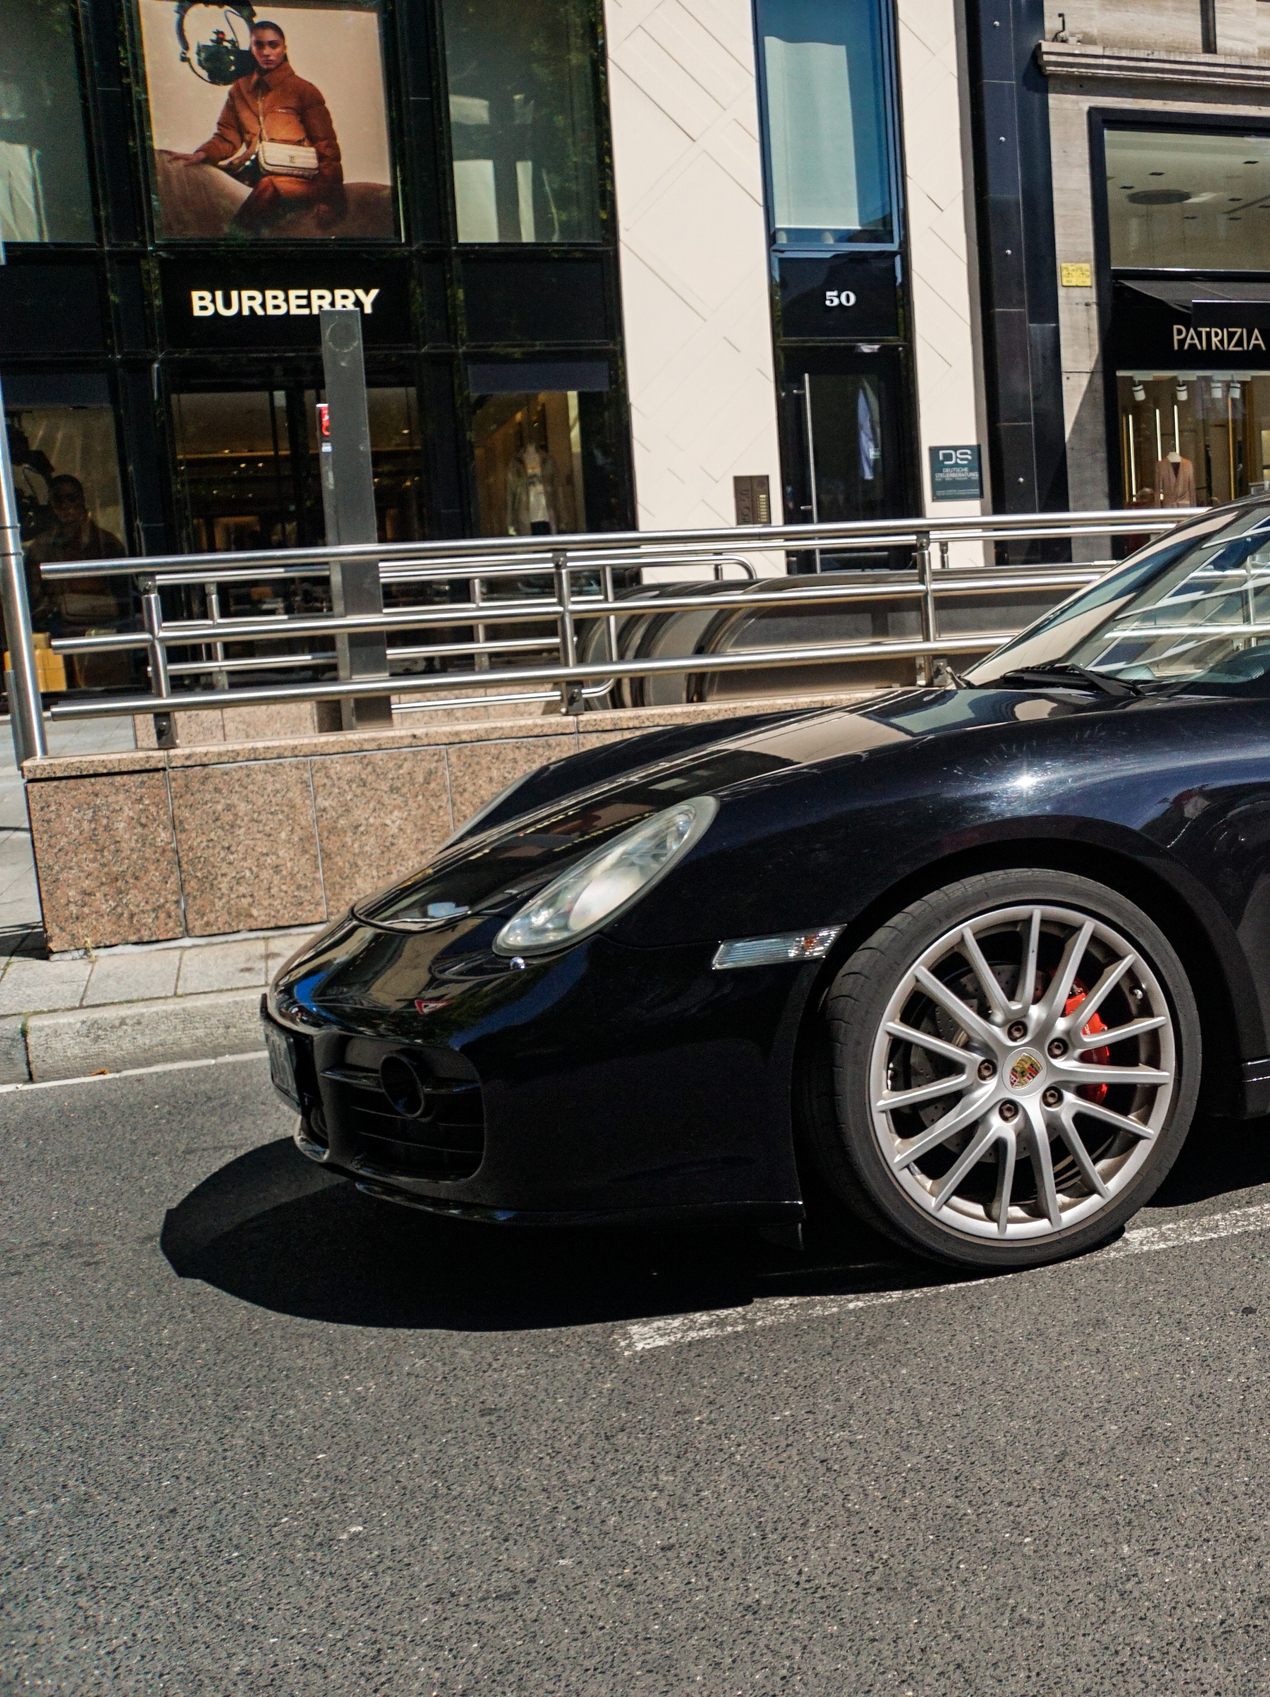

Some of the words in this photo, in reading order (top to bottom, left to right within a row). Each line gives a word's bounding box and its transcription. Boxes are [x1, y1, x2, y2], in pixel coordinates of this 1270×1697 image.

[190, 289, 380, 316] BURBERRY
[825, 290, 857, 307] 50
[1173, 324, 1266, 351] PATRIZIA
[939, 449, 972, 465] DS
